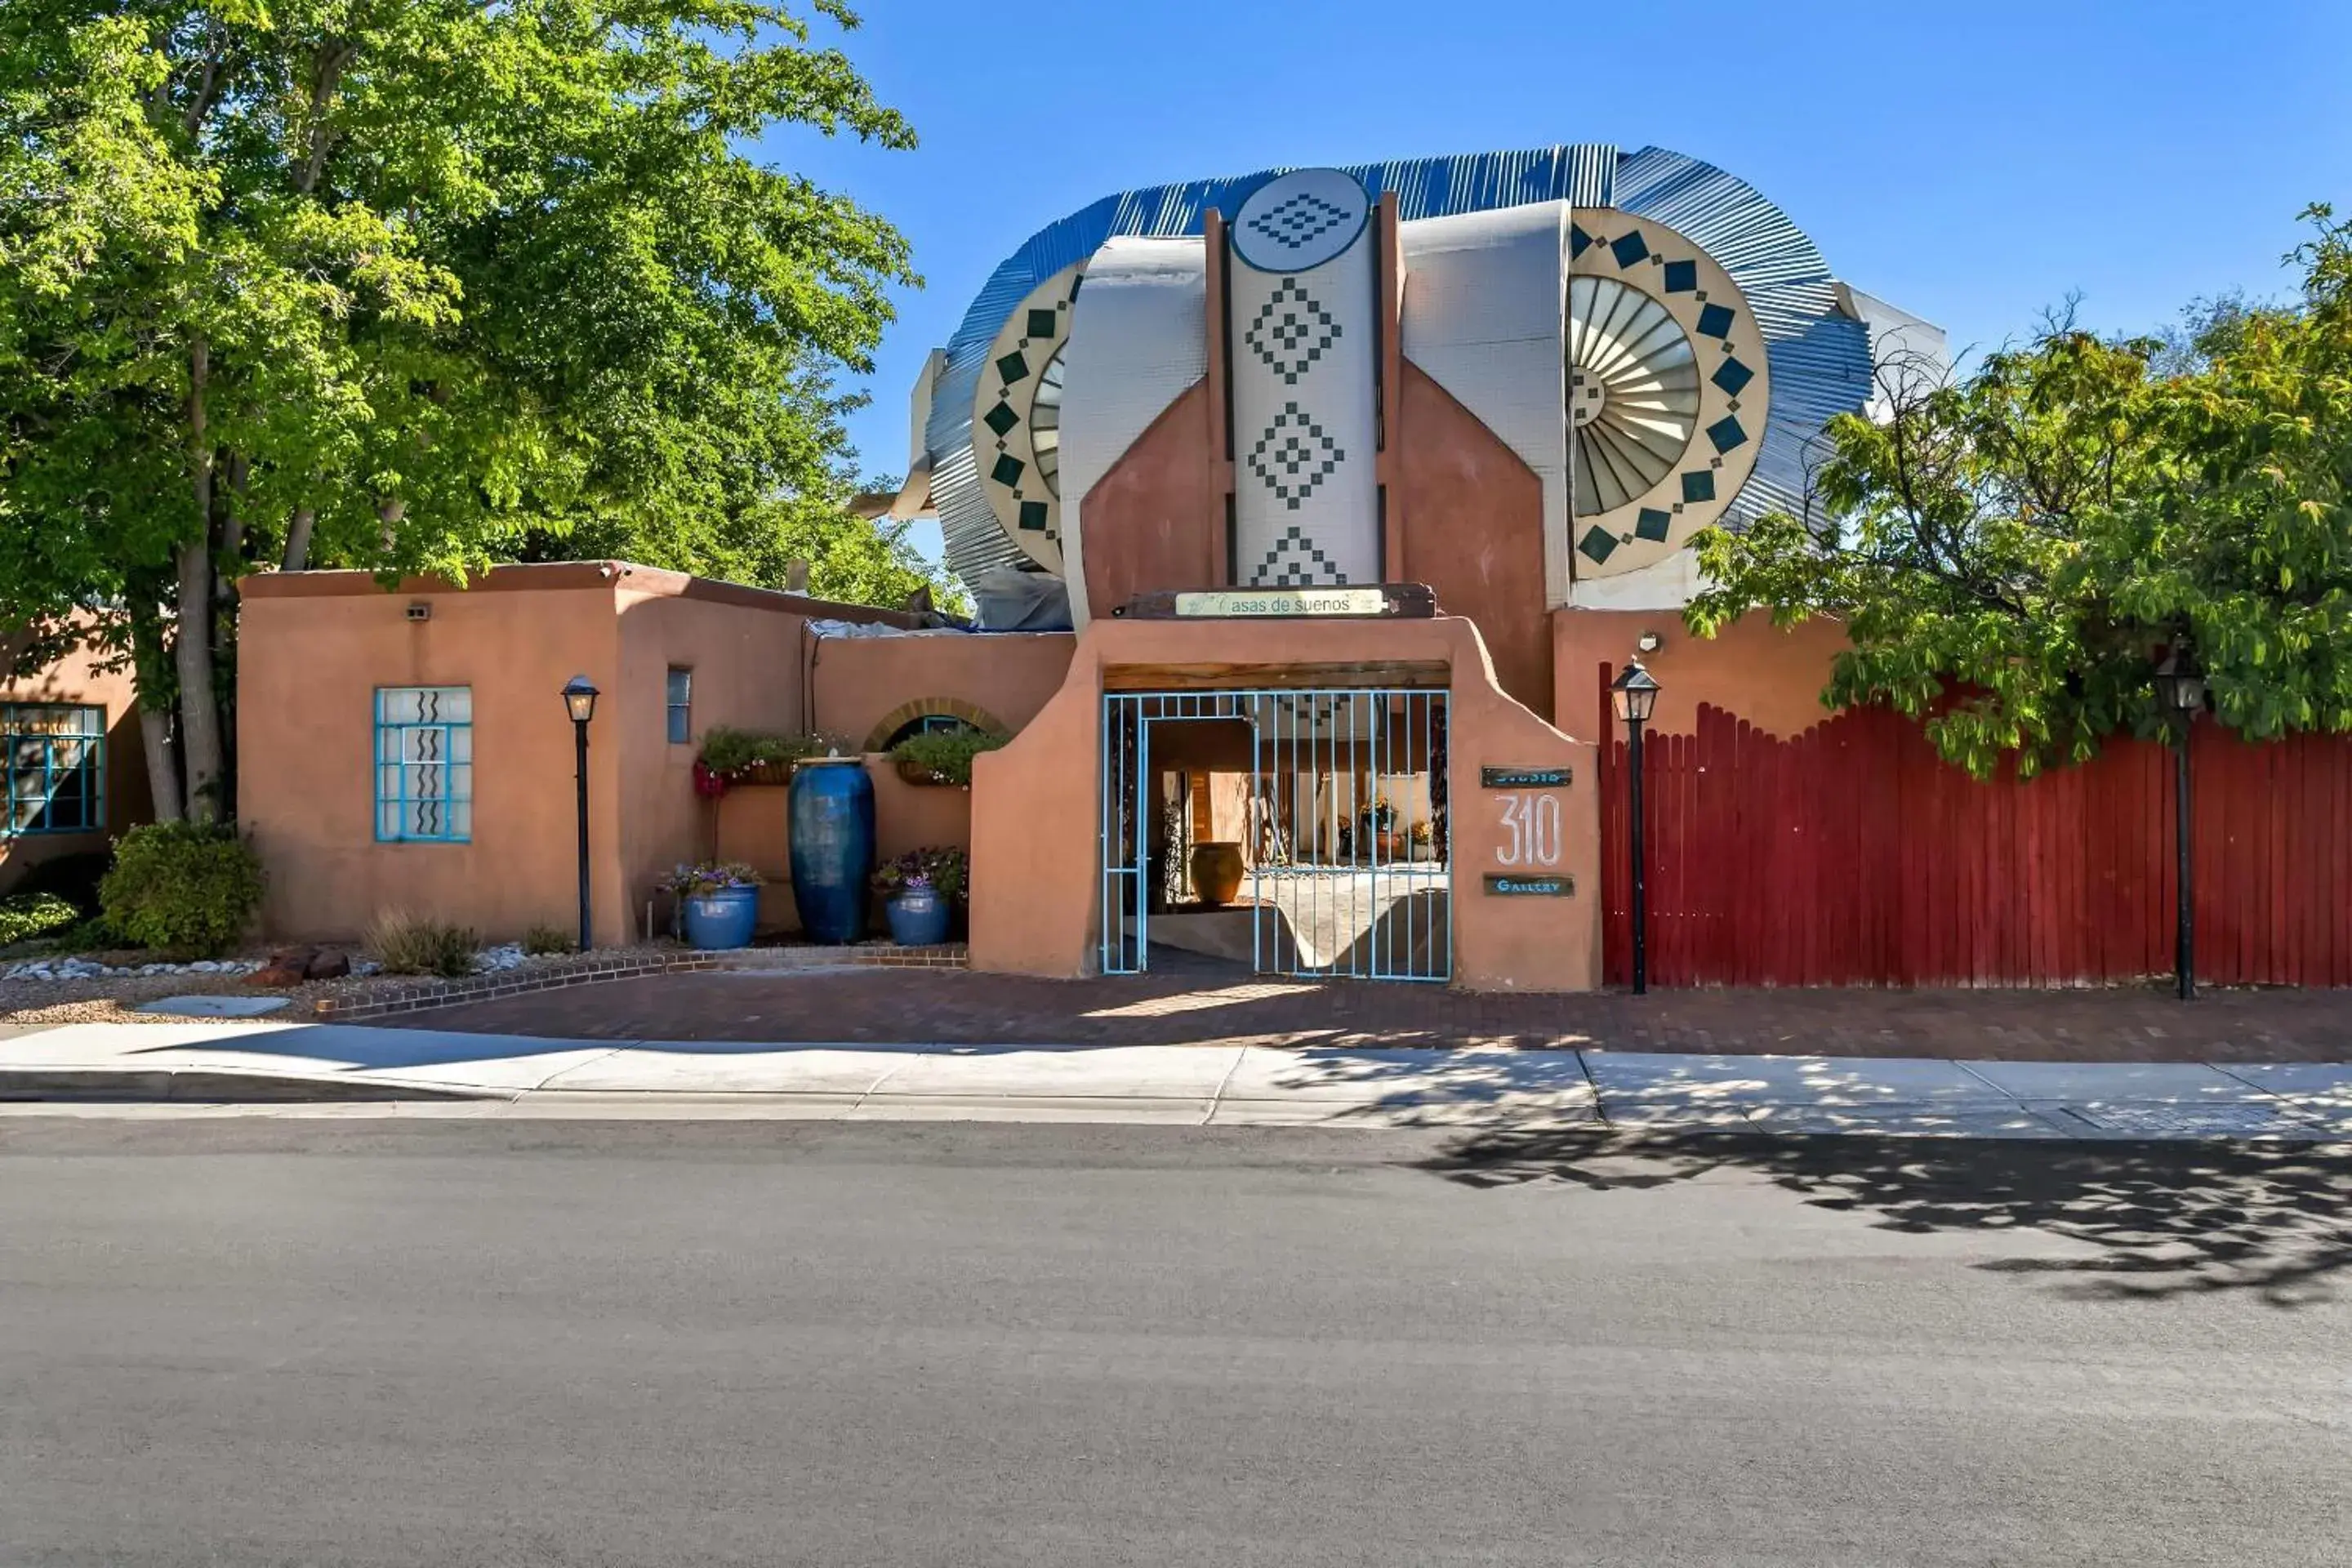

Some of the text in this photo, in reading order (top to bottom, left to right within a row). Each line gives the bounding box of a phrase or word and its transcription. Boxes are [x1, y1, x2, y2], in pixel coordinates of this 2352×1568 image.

[1271, 597, 1290, 612] de
[1294, 599, 1350, 612] suenos
[1494, 794, 1559, 866] 310
